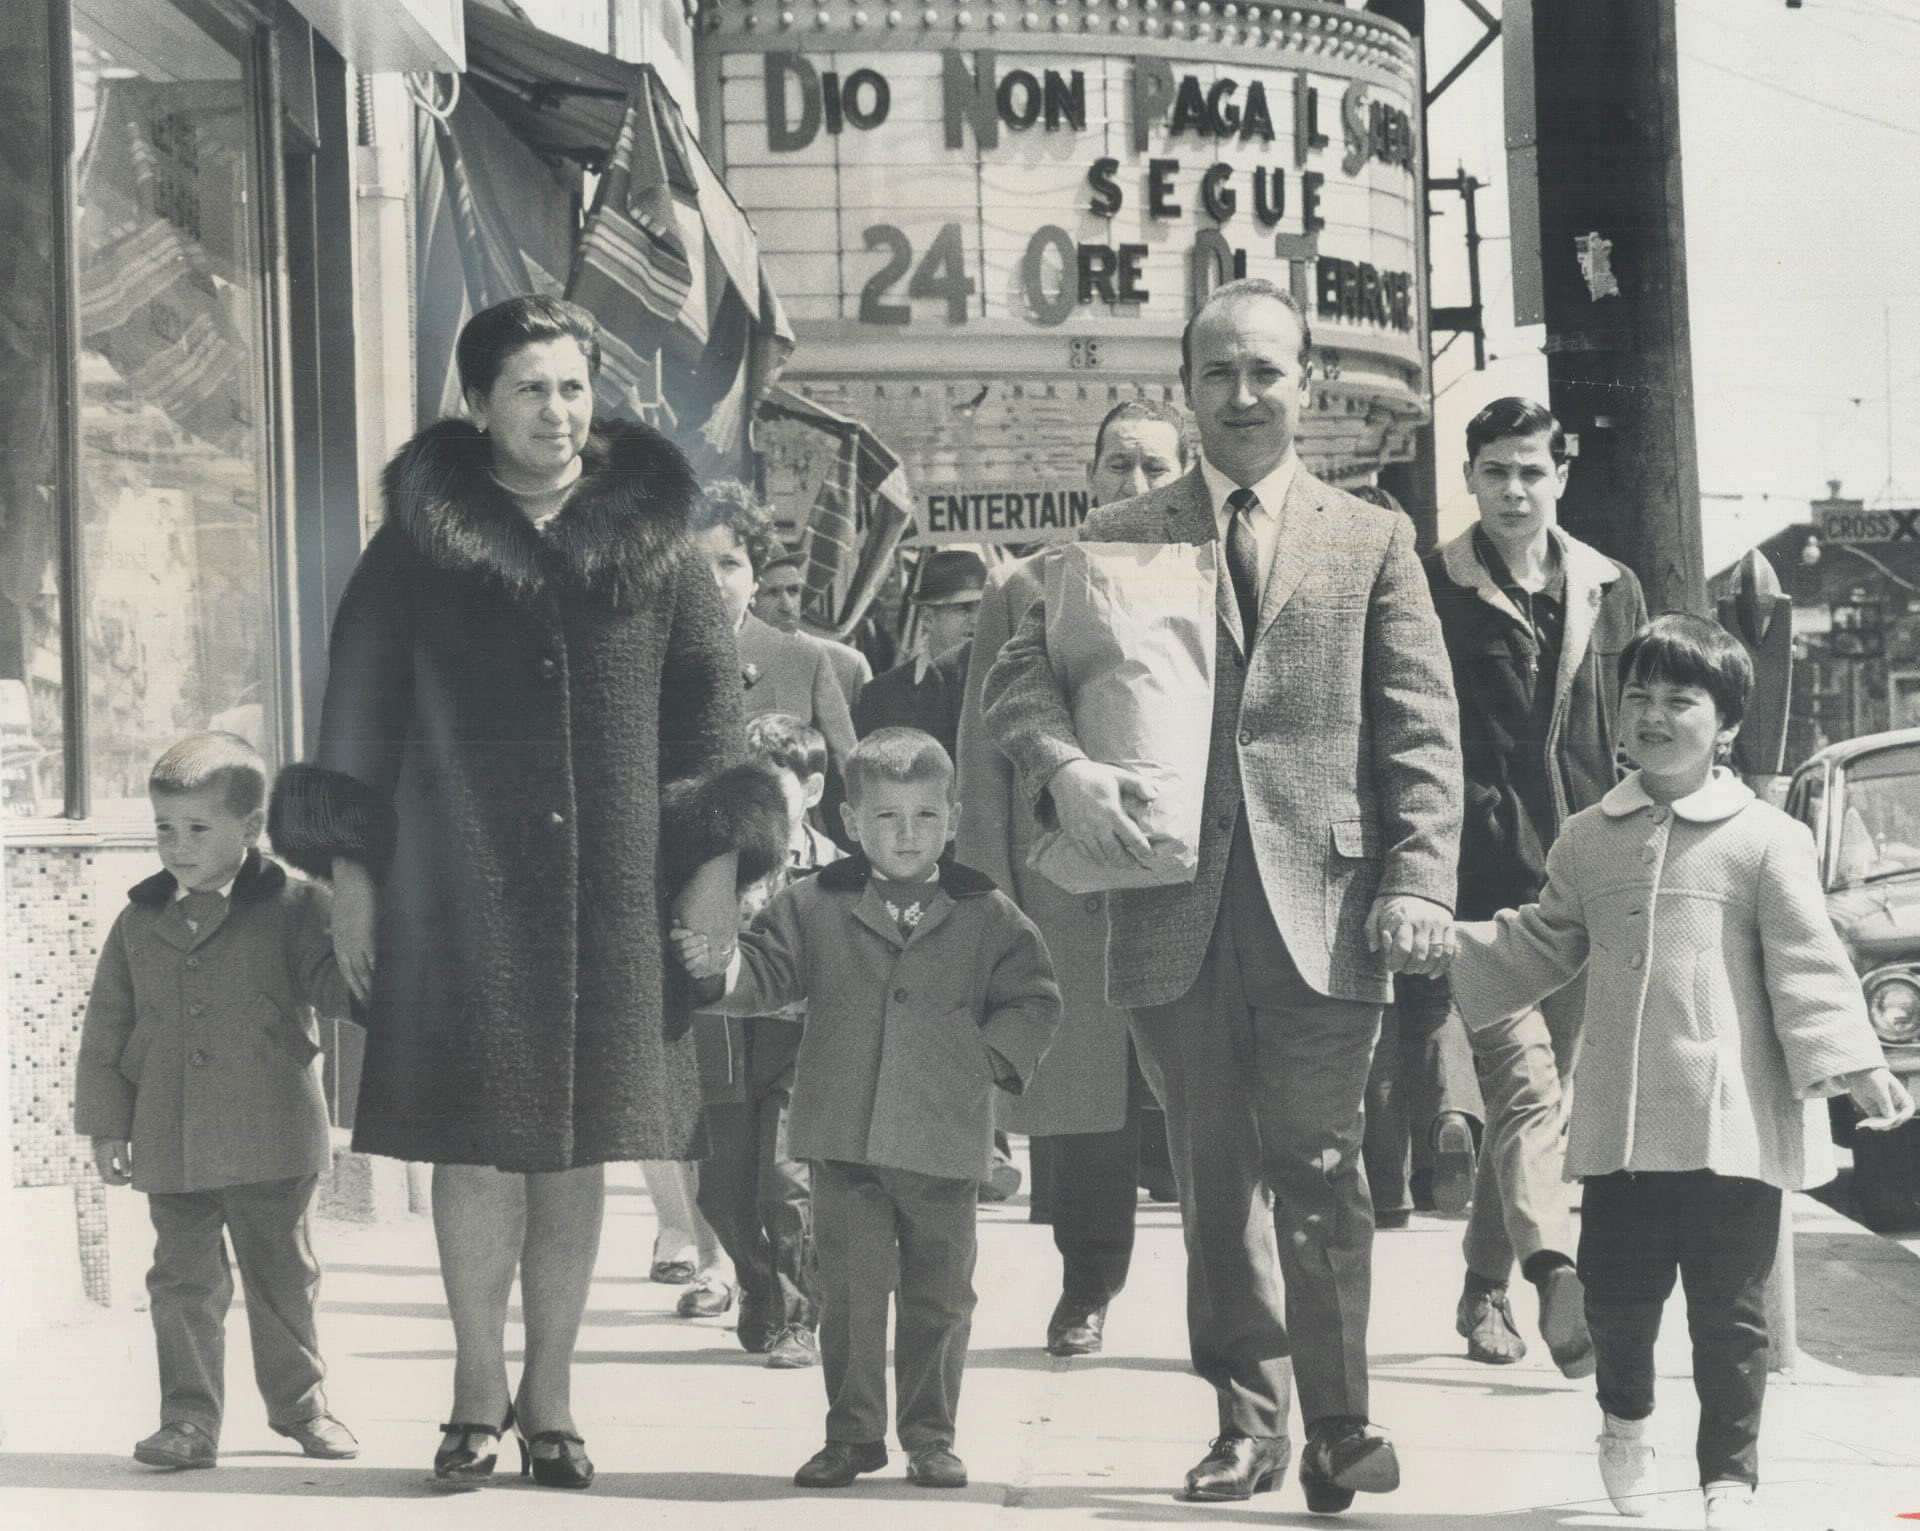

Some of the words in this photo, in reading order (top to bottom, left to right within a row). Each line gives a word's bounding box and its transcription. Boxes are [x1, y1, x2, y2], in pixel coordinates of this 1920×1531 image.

[764, 50, 890, 152] DIO
[942, 48, 1087, 149] NON
[1131, 54, 1276, 153] PAGA
[1087, 158, 1325, 234] SEGUE
[859, 223, 976, 324] 24
[1022, 224, 1150, 325] ORE
[928, 491, 1099, 532] ENTERTAIN
